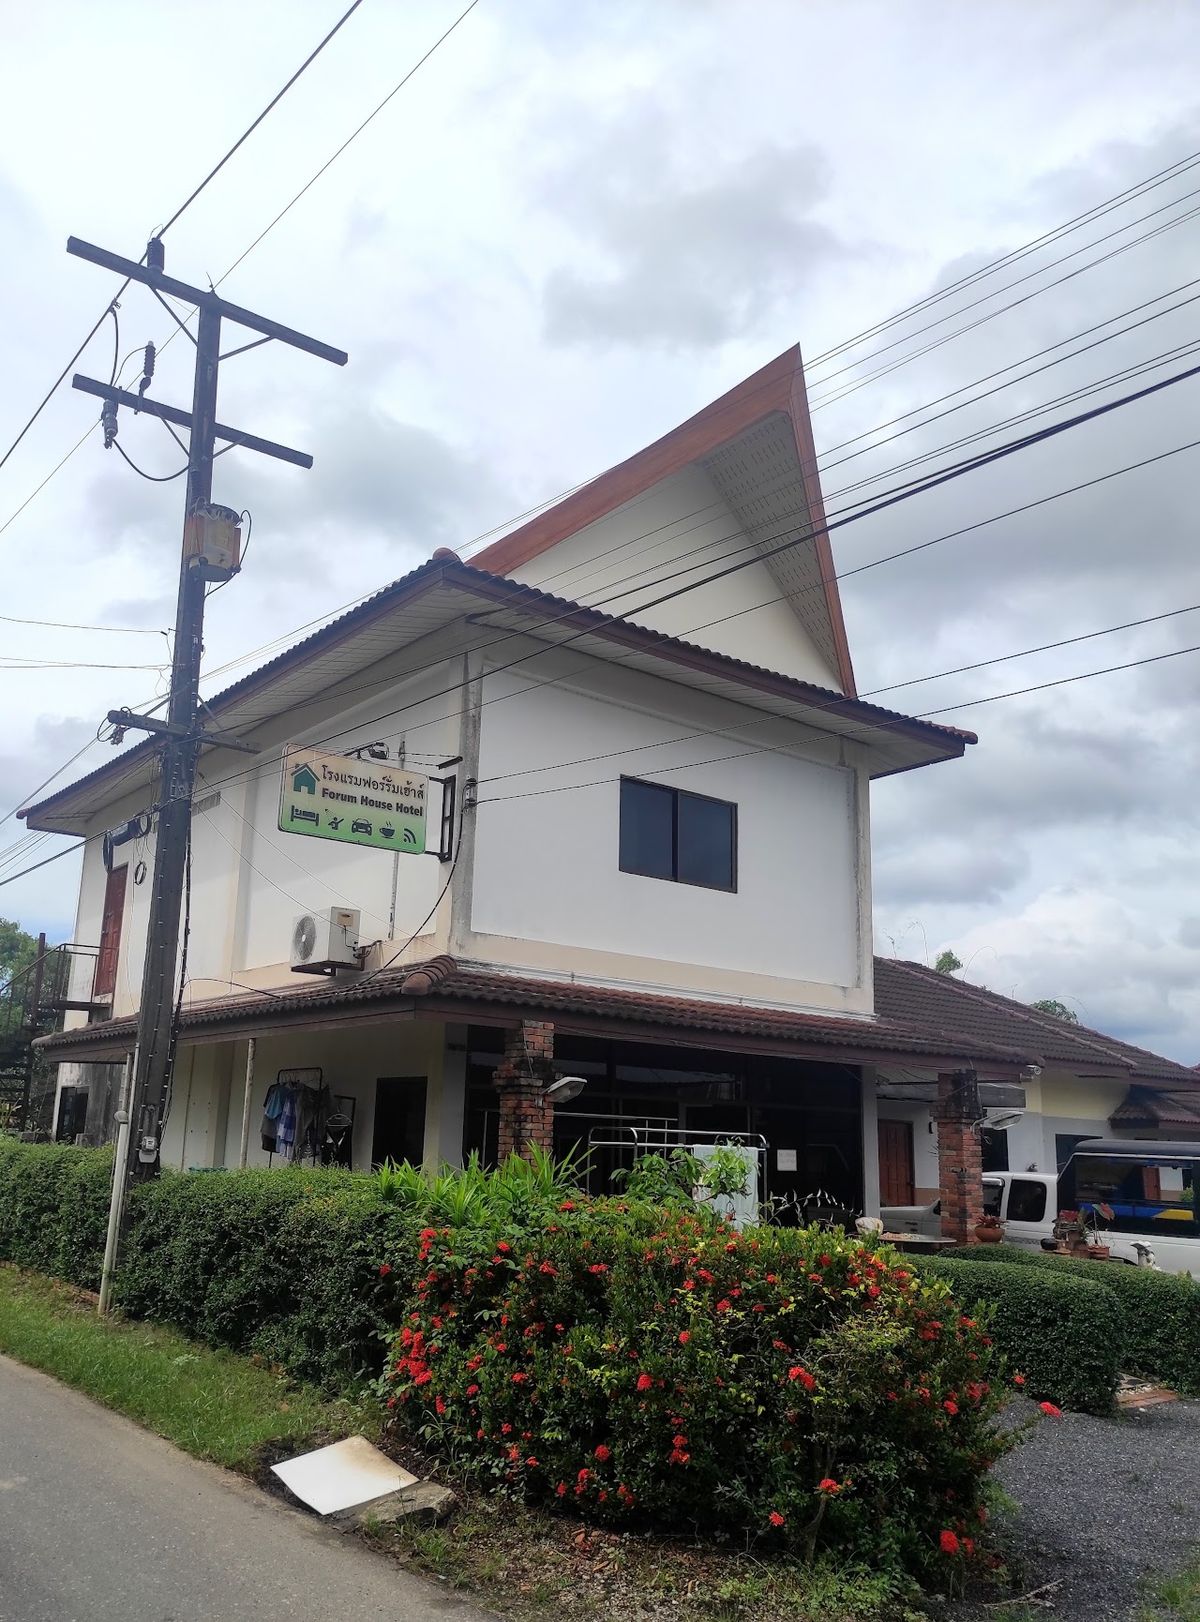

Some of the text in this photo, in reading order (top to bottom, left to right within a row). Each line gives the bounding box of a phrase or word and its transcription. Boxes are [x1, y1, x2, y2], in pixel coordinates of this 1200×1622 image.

[321, 787, 423, 817] Forum House Hotel
